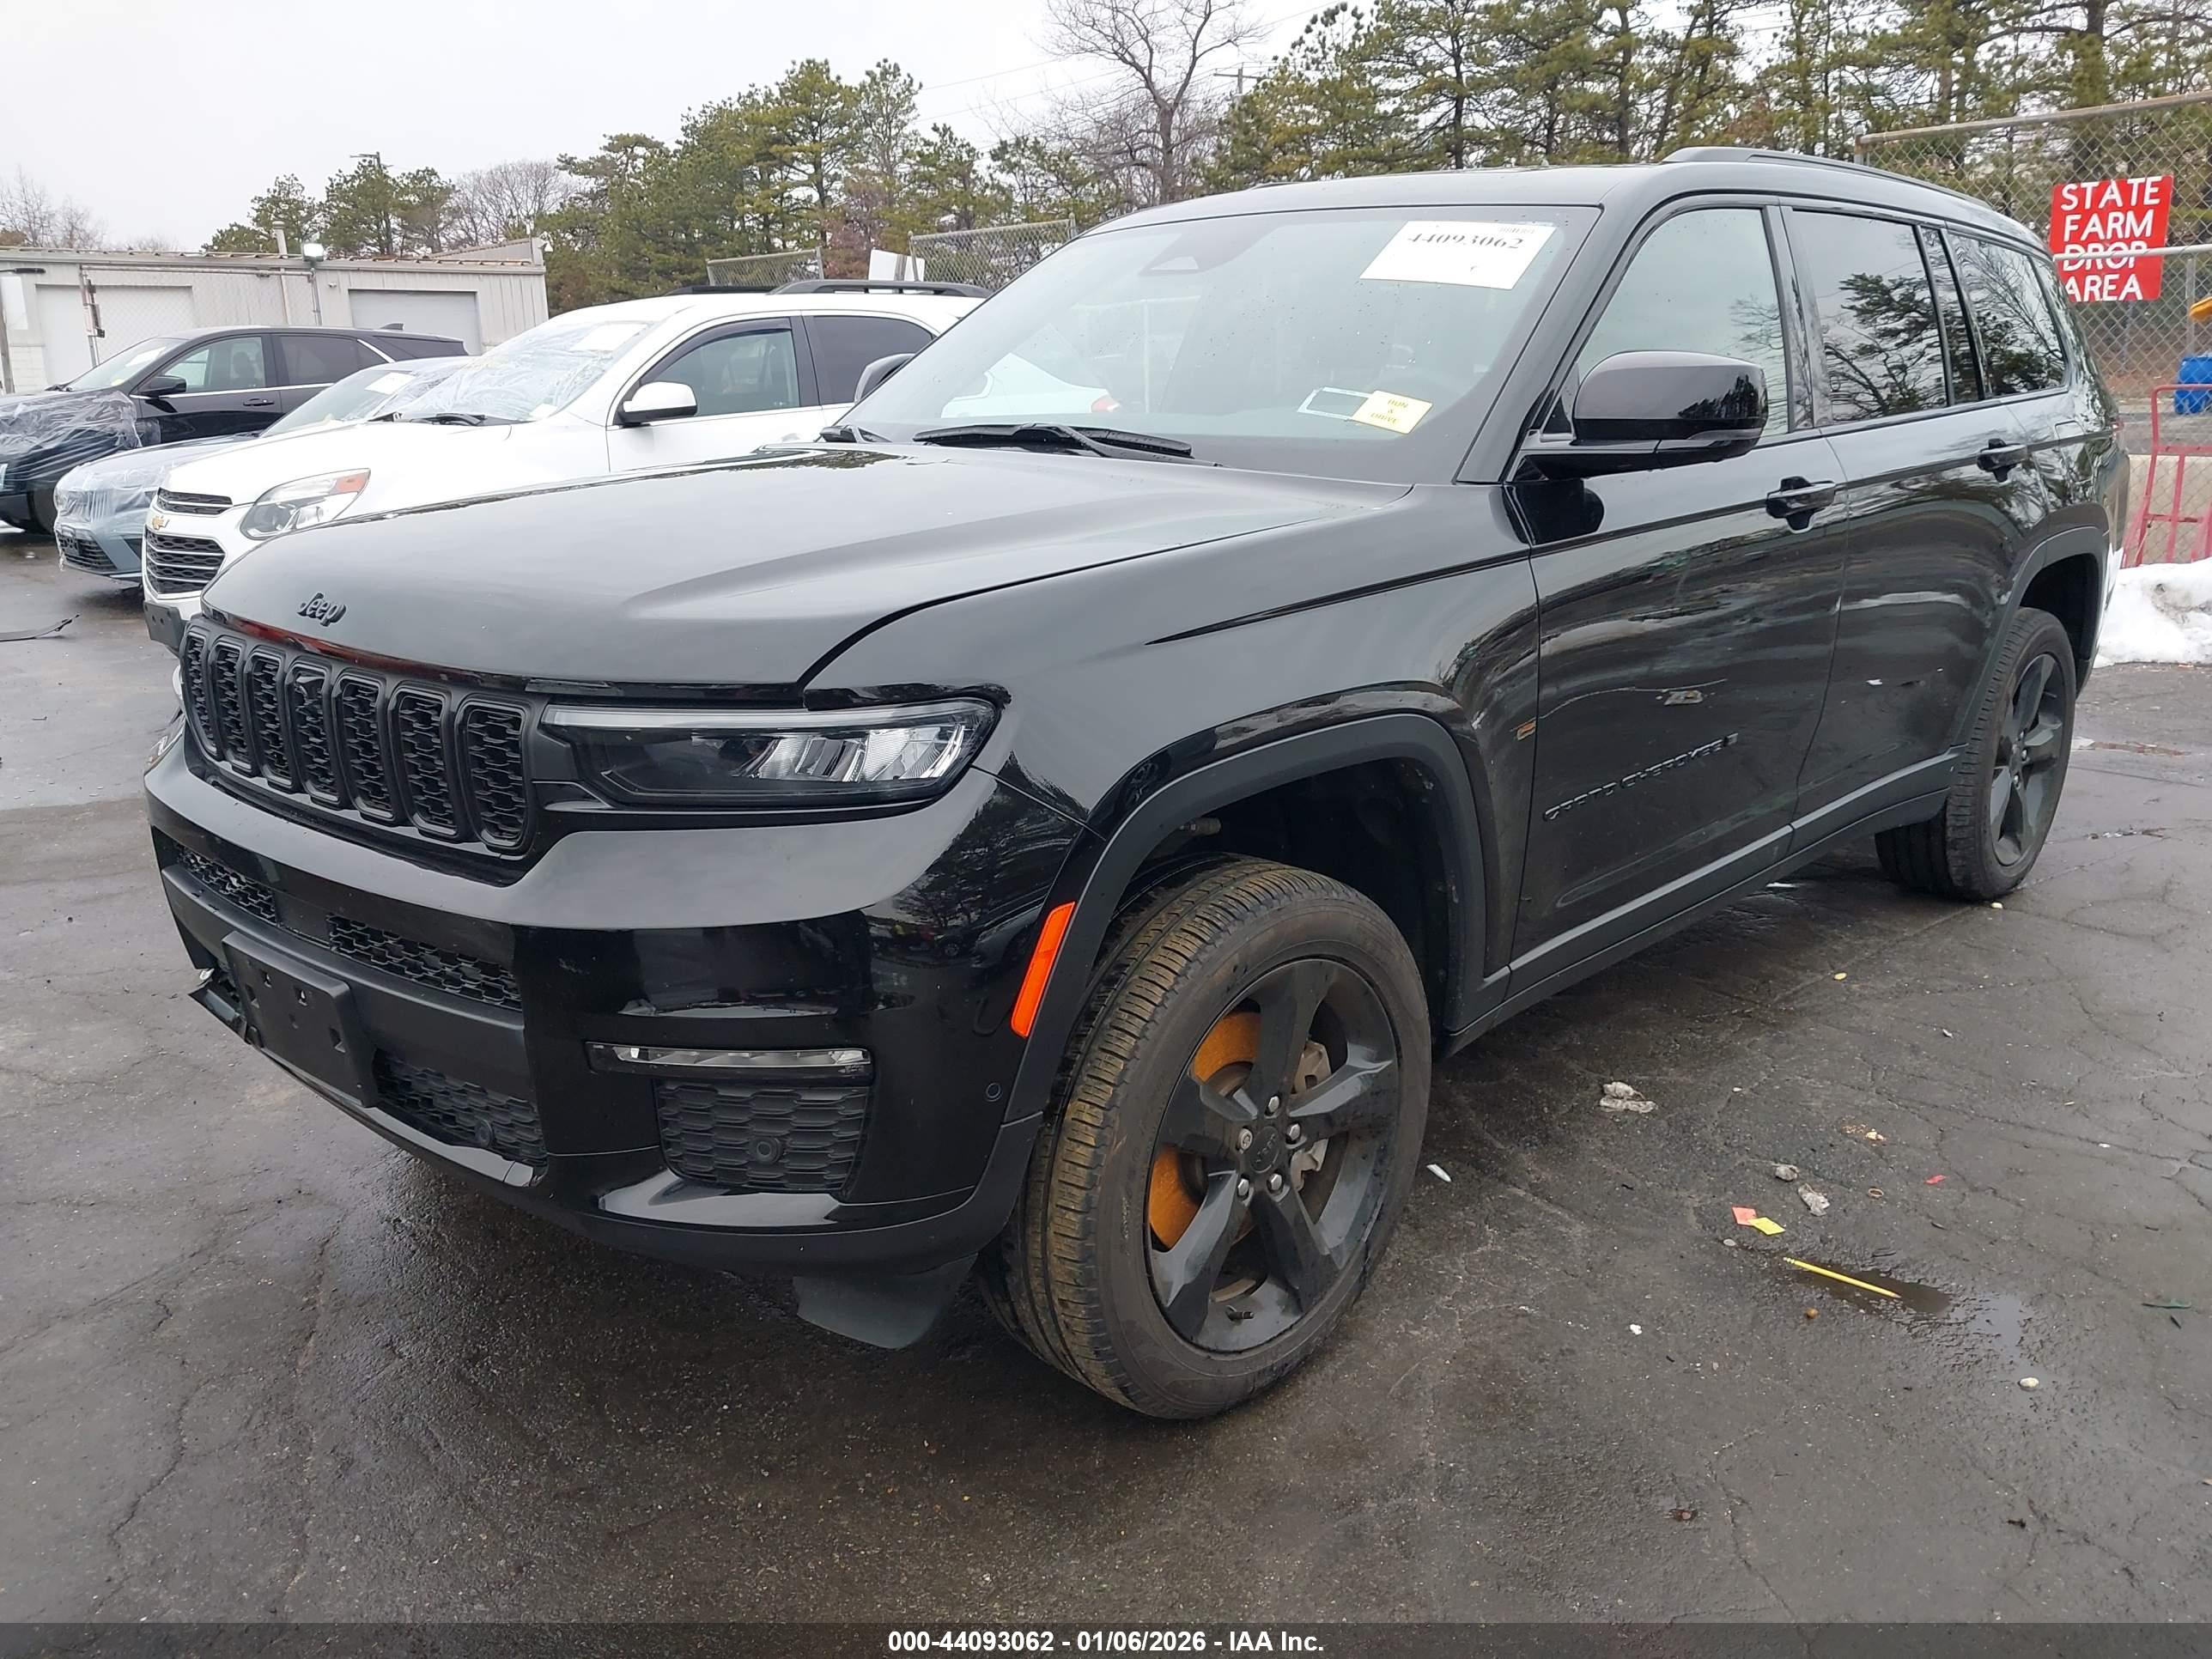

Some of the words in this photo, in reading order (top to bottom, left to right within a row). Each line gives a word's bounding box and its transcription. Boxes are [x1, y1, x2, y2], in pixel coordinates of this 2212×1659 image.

[2061, 175, 2162, 211] STATE
[1407, 233, 1524, 249] 44093062
[2063, 209, 2154, 242] FARM
[2063, 240, 2148, 271] DROP
[2065, 273, 2143, 302] AREA
[296, 592, 347, 628] Jeep
